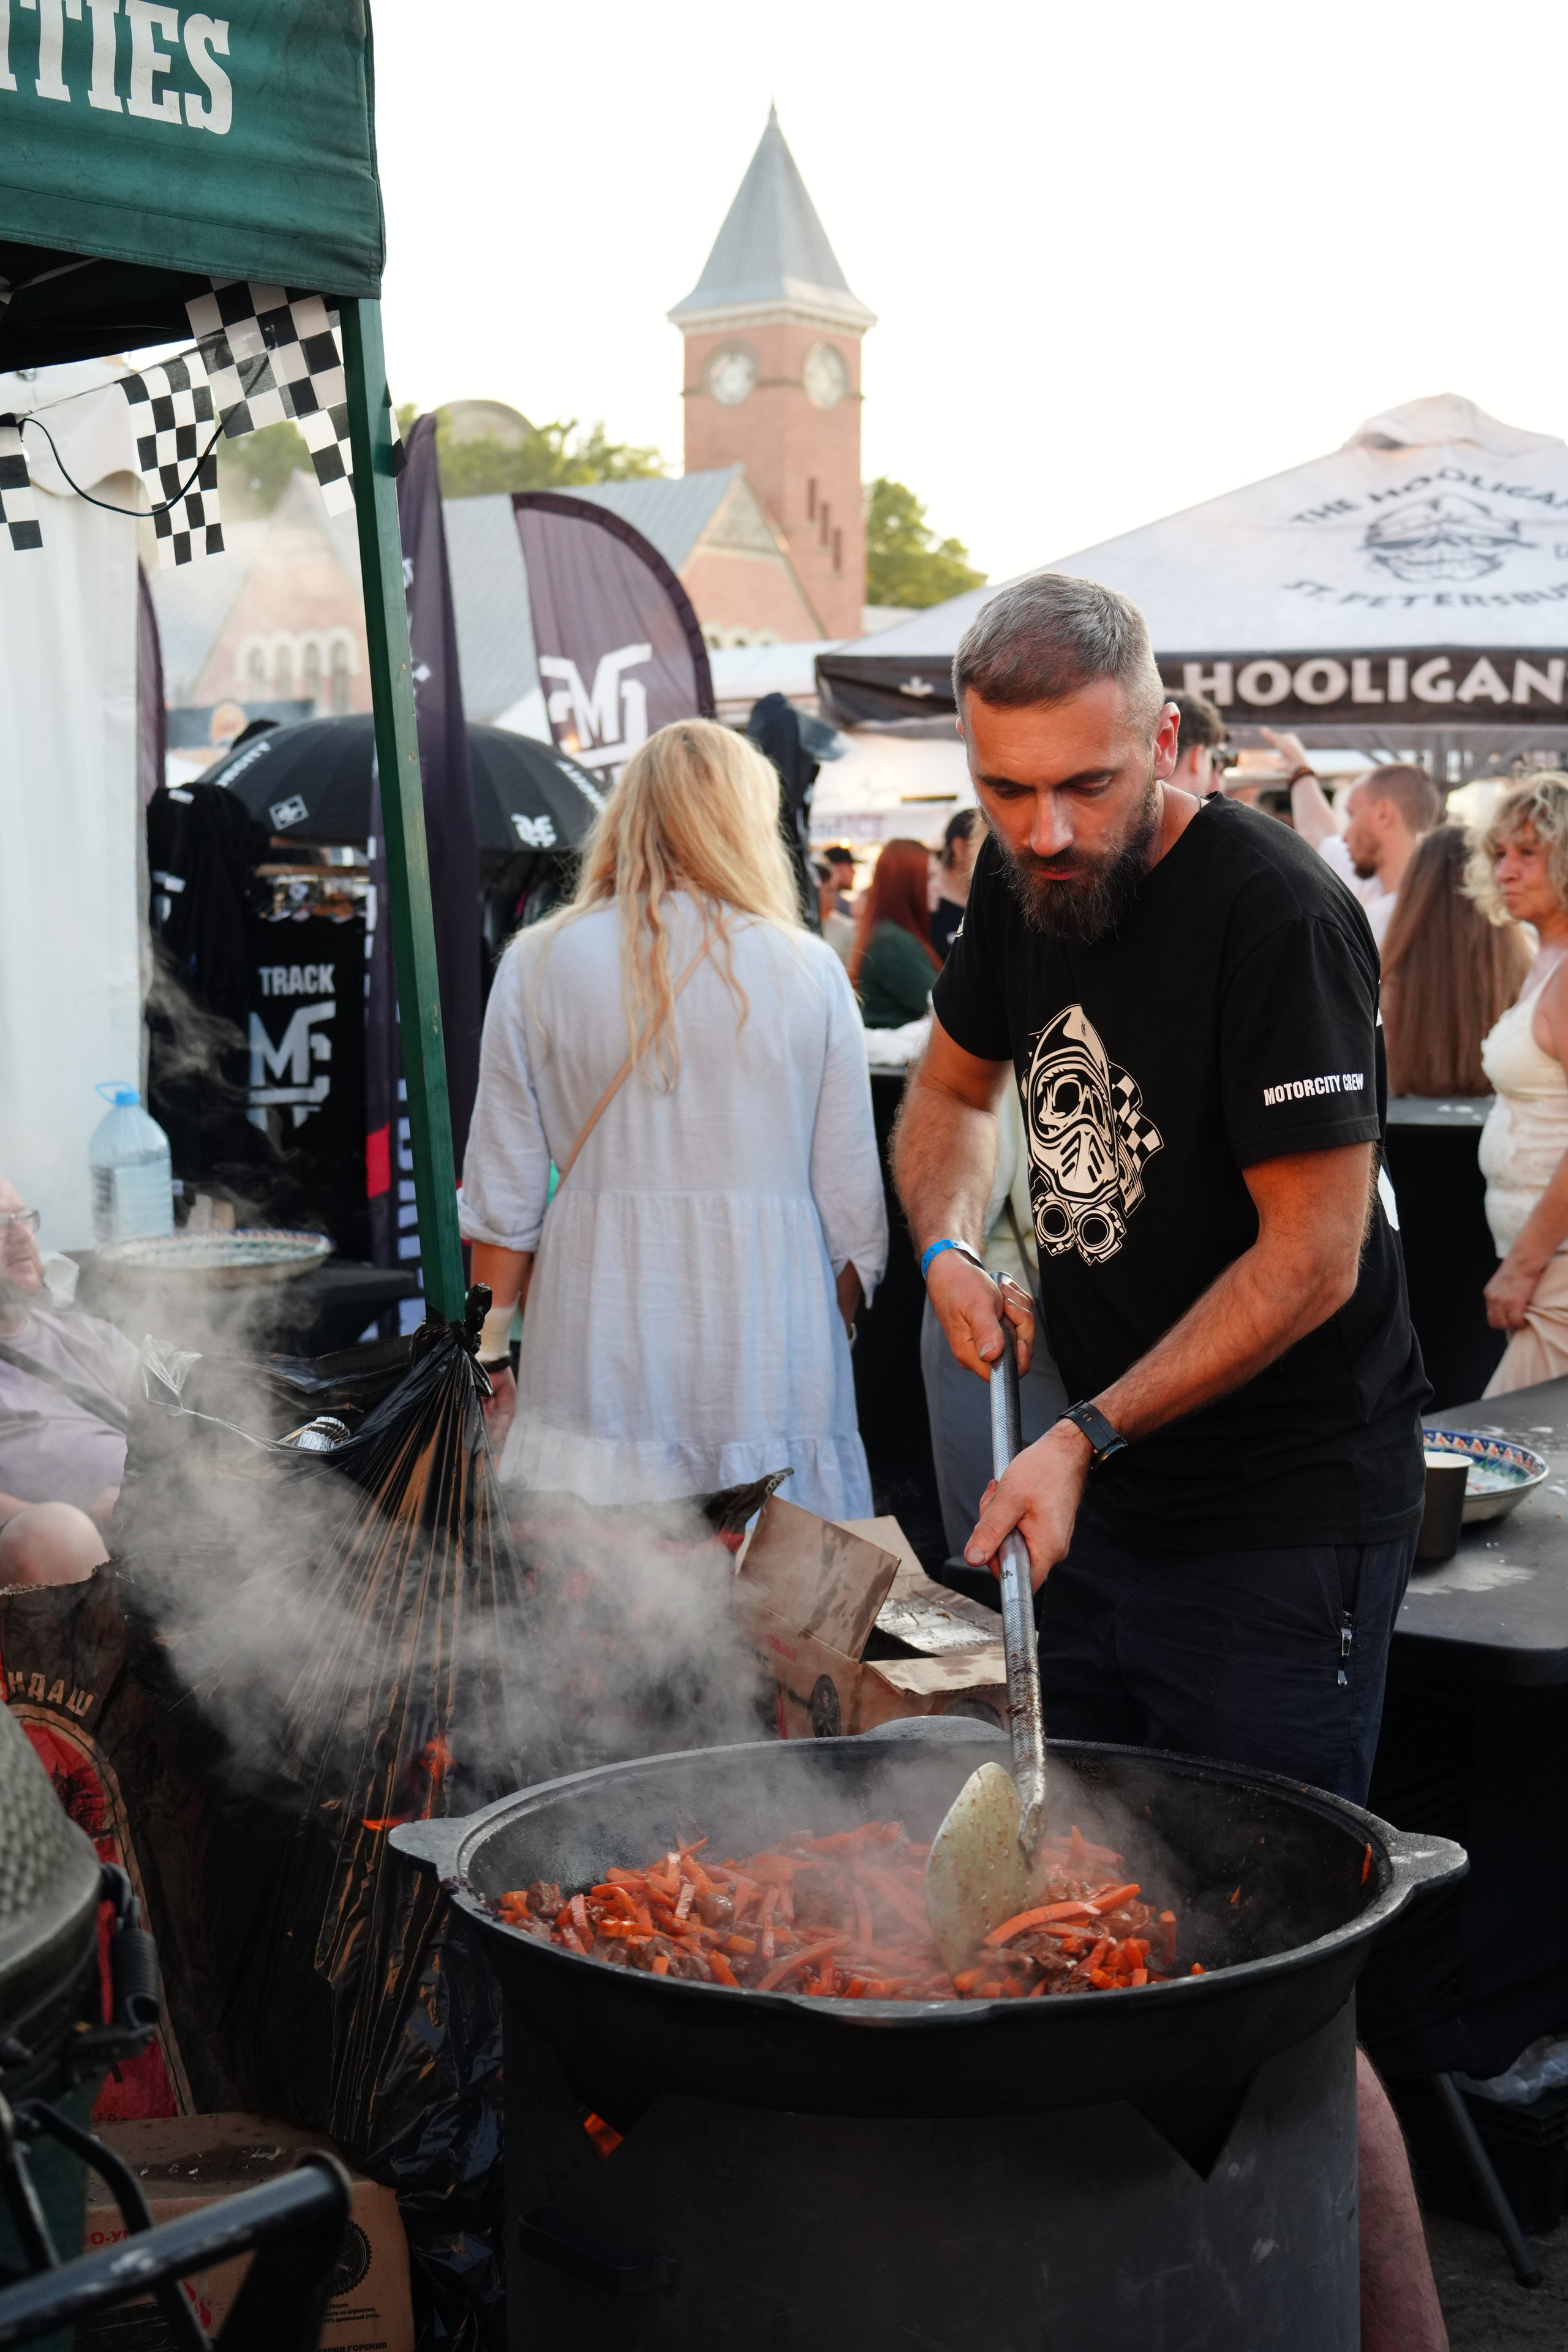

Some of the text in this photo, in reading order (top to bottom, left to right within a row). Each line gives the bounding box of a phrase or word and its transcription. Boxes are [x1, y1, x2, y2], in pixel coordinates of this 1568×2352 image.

[1289, 499, 1361, 525] THE
[1337, 582, 1568, 608] PETERSBU
[258, 963, 336, 996] TRACK
[1264, 1073, 1364, 1106] MOTORCITY CREW
[347, 2341, 387, 2351] ГОРЕНИЯ
